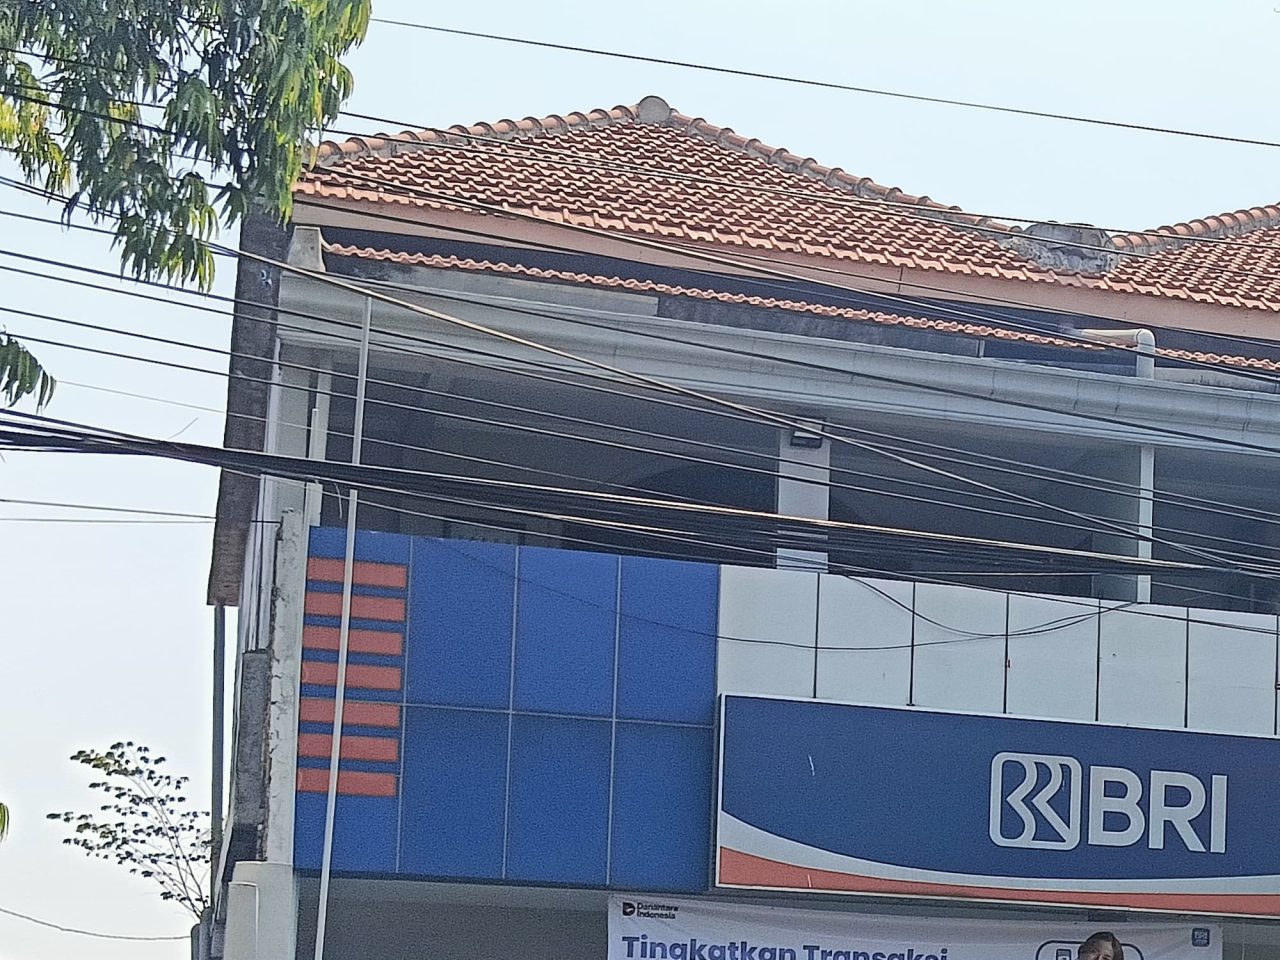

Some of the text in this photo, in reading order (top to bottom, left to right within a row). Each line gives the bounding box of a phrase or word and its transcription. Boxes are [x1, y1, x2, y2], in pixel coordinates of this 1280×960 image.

[1087, 765, 1228, 854] BRI
[636, 902, 679, 912] Danantara
[636, 910, 676, 919] Indonesia
